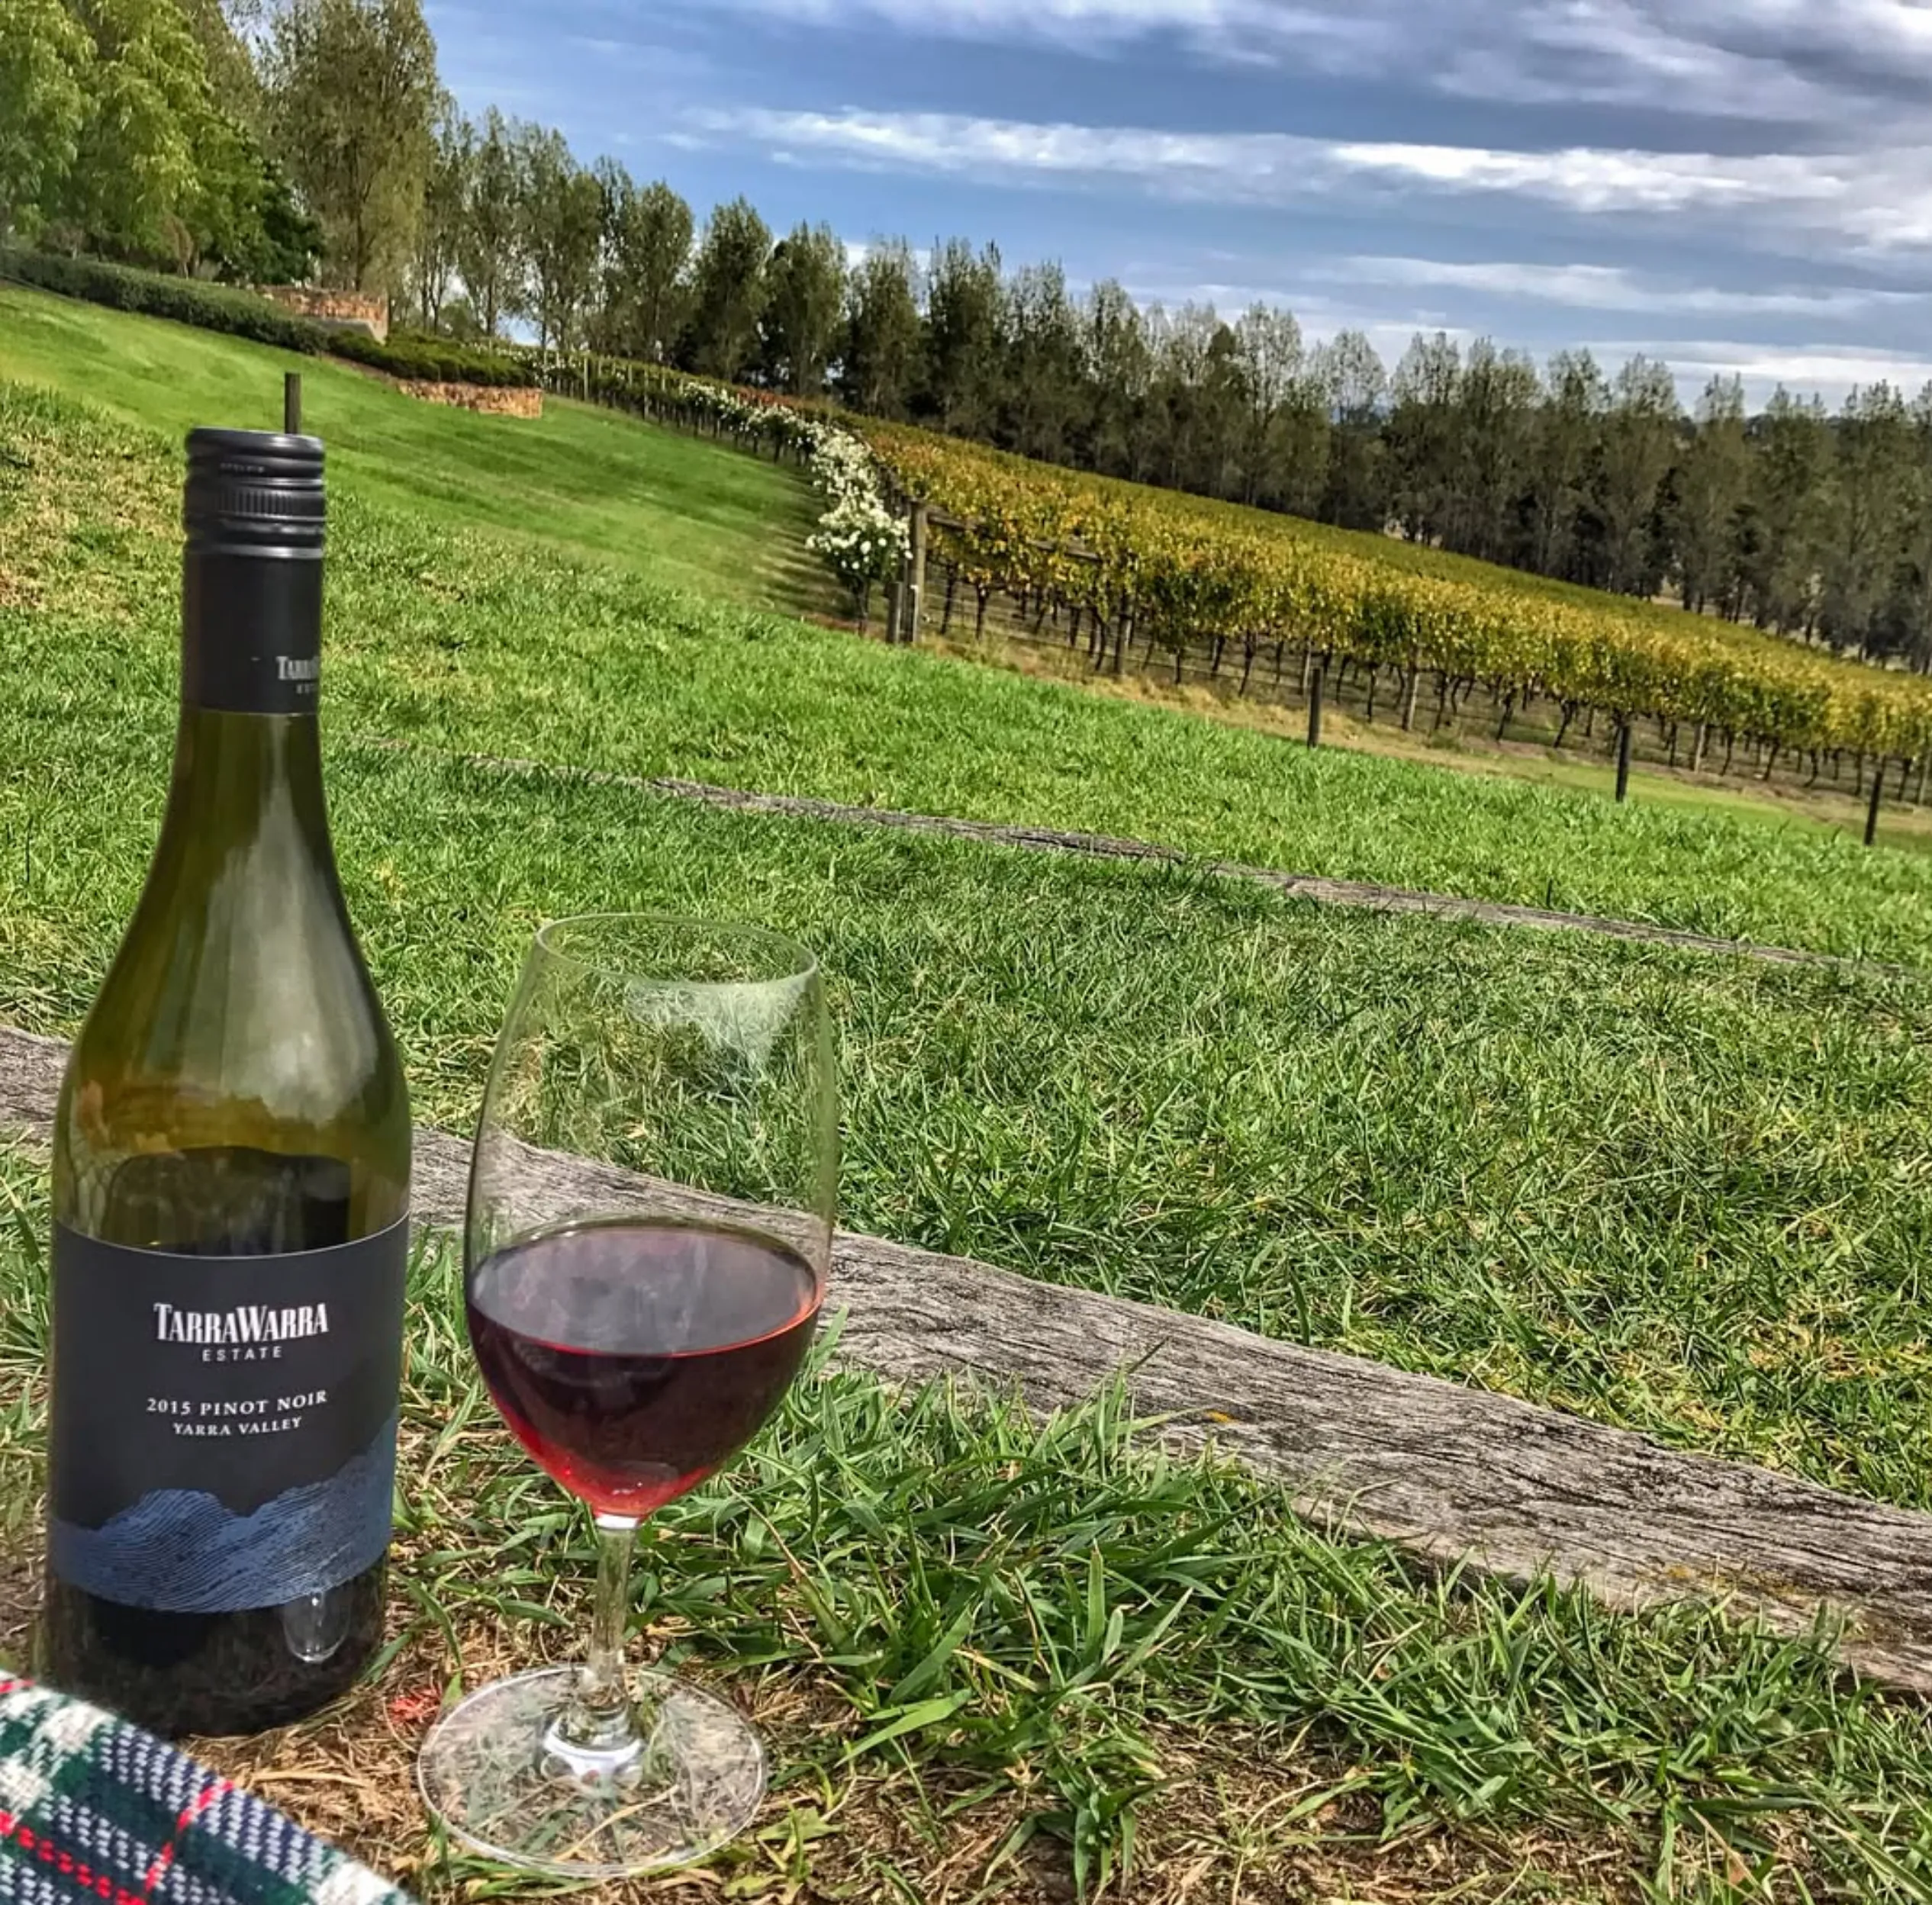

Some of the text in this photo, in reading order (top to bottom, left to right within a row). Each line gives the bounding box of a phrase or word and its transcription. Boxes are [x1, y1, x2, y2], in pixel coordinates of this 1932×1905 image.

[202, 1346, 282, 1362] ESTATE
[147, 1390, 327, 1416] 2015 PINOT NOIR
[172, 1416, 302, 1436] YARRA VALLEY
